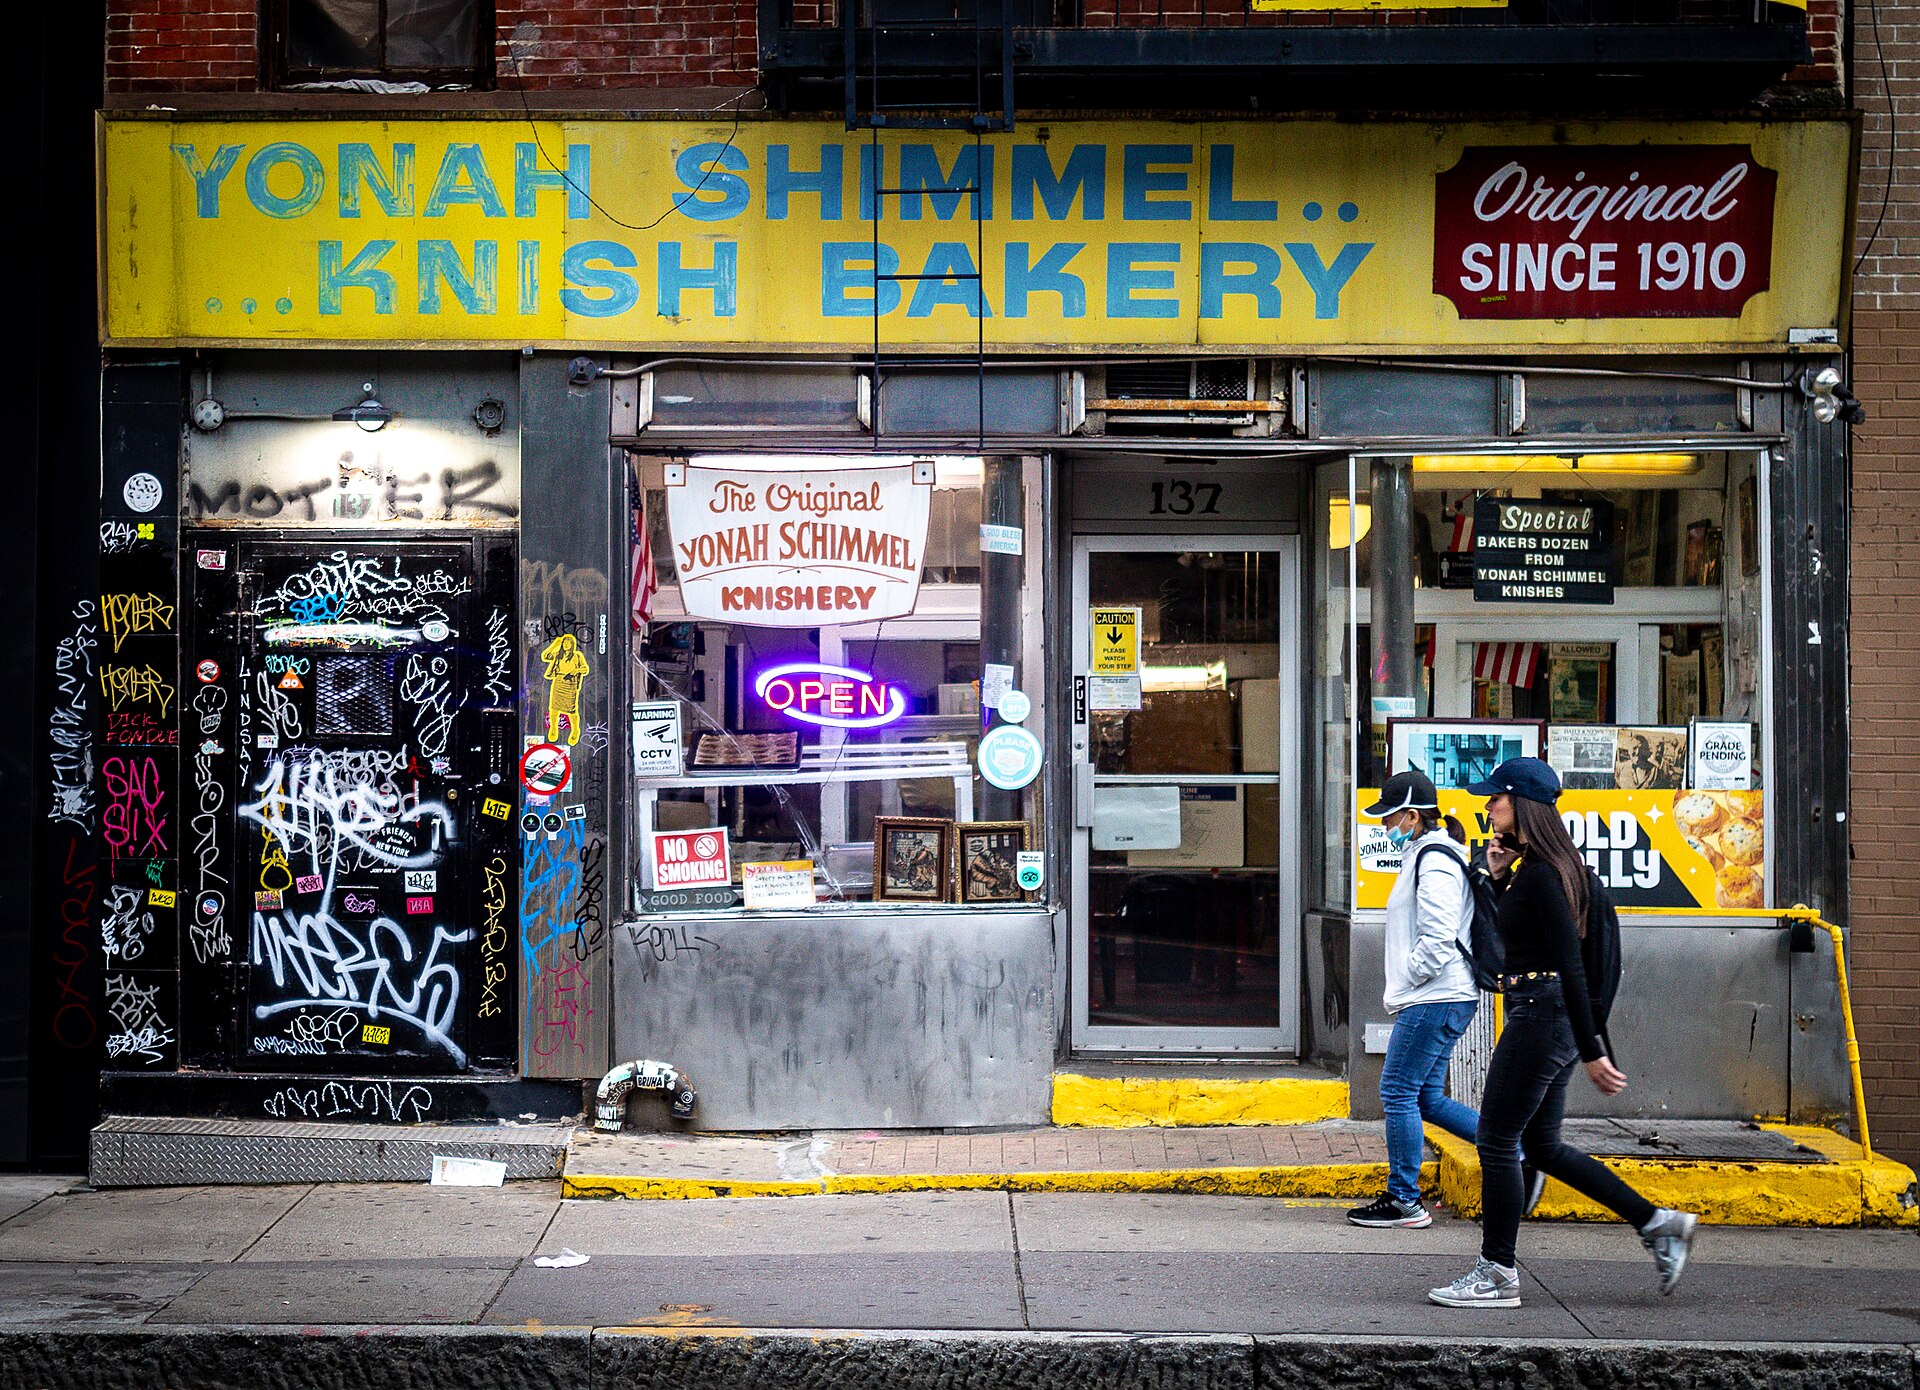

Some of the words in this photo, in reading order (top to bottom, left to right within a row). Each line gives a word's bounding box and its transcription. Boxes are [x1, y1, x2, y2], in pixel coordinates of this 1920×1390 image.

[169, 141, 591, 219] YONAH
[1473, 161, 1748, 241] Original
[1459, 242, 1618, 292] SINCE
[1638, 241, 1746, 291] 1910
[821, 241, 1375, 320] BAKERY
[709, 480, 756, 513] The
[765, 481, 883, 518] Original
[1149, 478, 1223, 515] 137
[1501, 505, 1593, 532] Special
[987, 528, 1000, 538] GOD
[1002, 529, 1021, 540] BLESS
[679, 523, 769, 573] YONAH
[779, 520, 917, 571] SCHIMMEL
[990, 541, 1018, 552] AMERICA
[1477, 536, 1537, 549] BAKERS
[1541, 537, 1589, 550] DOZEN
[1525, 554, 1564, 566] FROM
[1478, 568, 1528, 581] YONAH
[1533, 571, 1606, 583] SCHIMMEL
[721, 586, 877, 611] KNISHERY
[1502, 586, 1564, 598] KNISHES
[1095, 614, 1134, 624] CAUTION
[765, 679, 887, 715] OPEN
[1075, 680, 1084, 721] PULL
[107, 712, 158, 731] DICK
[633, 710, 675, 720] WARNING
[107, 728, 177, 744] FONDUE
[1705, 740, 1742, 750] GRADE
[641, 749, 672, 759] CCTV
[1700, 751, 1746, 760] PENDING
[381, 827, 413, 843] FRIENDS
[1369, 827, 1384, 838] The
[375, 841, 391, 852] NEW
[392, 846, 410, 857] YORK
[663, 838, 688, 862] NO
[1360, 841, 1388, 856] YONAH
[658, 859, 725, 883] SMOKING
[650, 894, 687, 906] GOOD
[695, 893, 733, 904] FOOD
